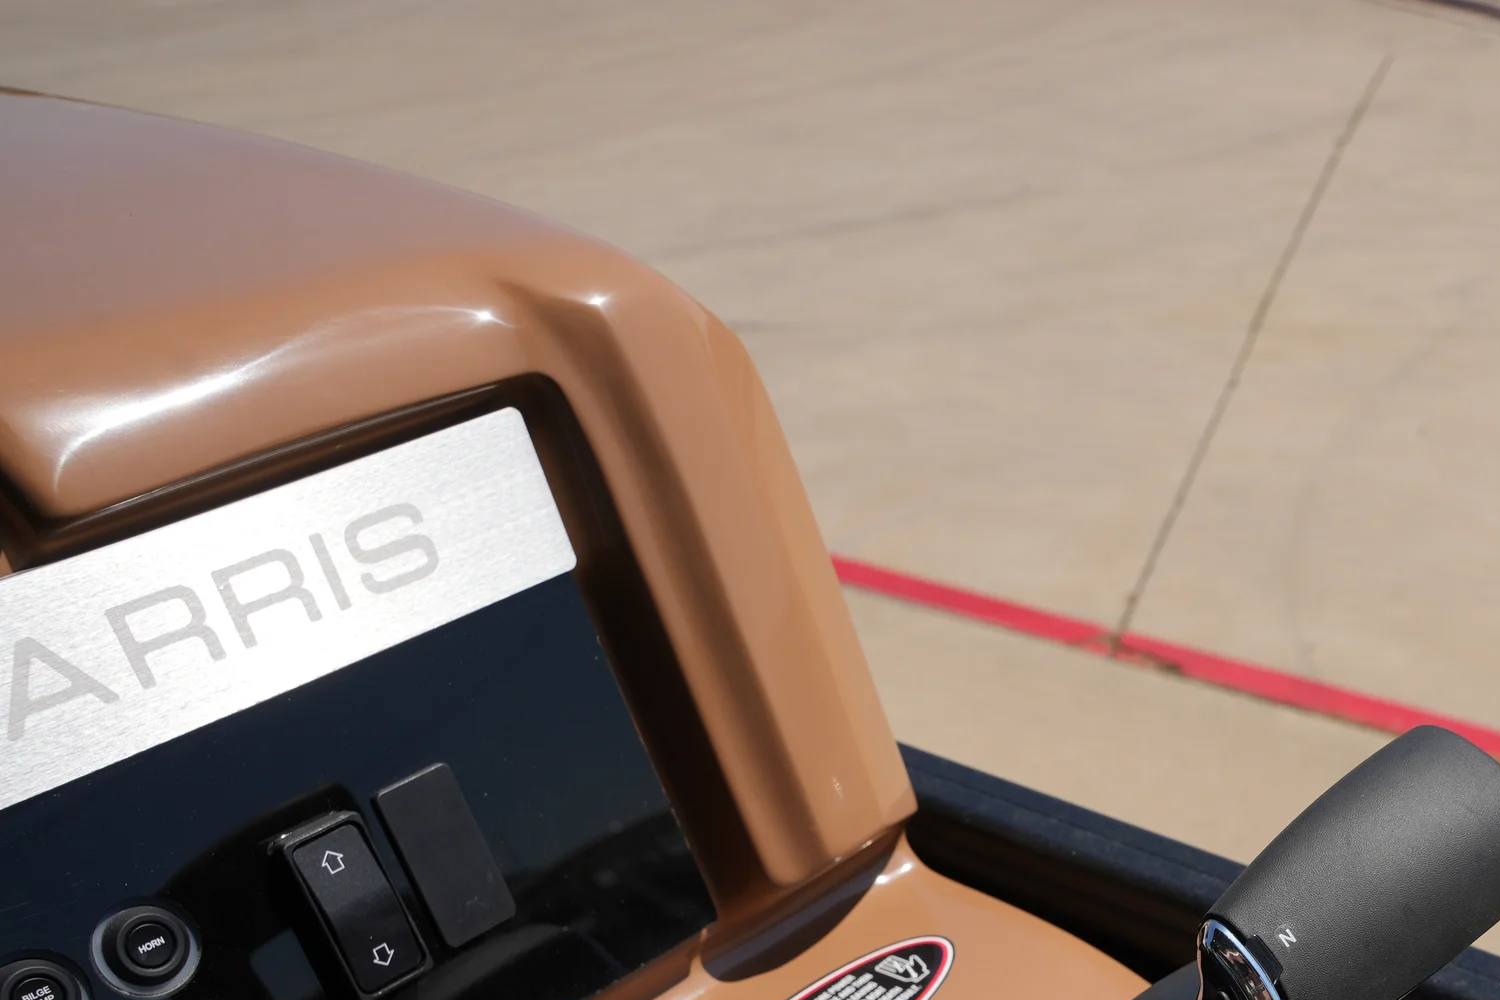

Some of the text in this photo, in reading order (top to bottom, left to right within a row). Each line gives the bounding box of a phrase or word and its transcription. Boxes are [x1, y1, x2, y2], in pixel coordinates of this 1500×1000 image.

[7, 502, 440, 741] ARRIS
[138, 936, 166, 955] HORN
[1278, 929, 1297, 947] N
